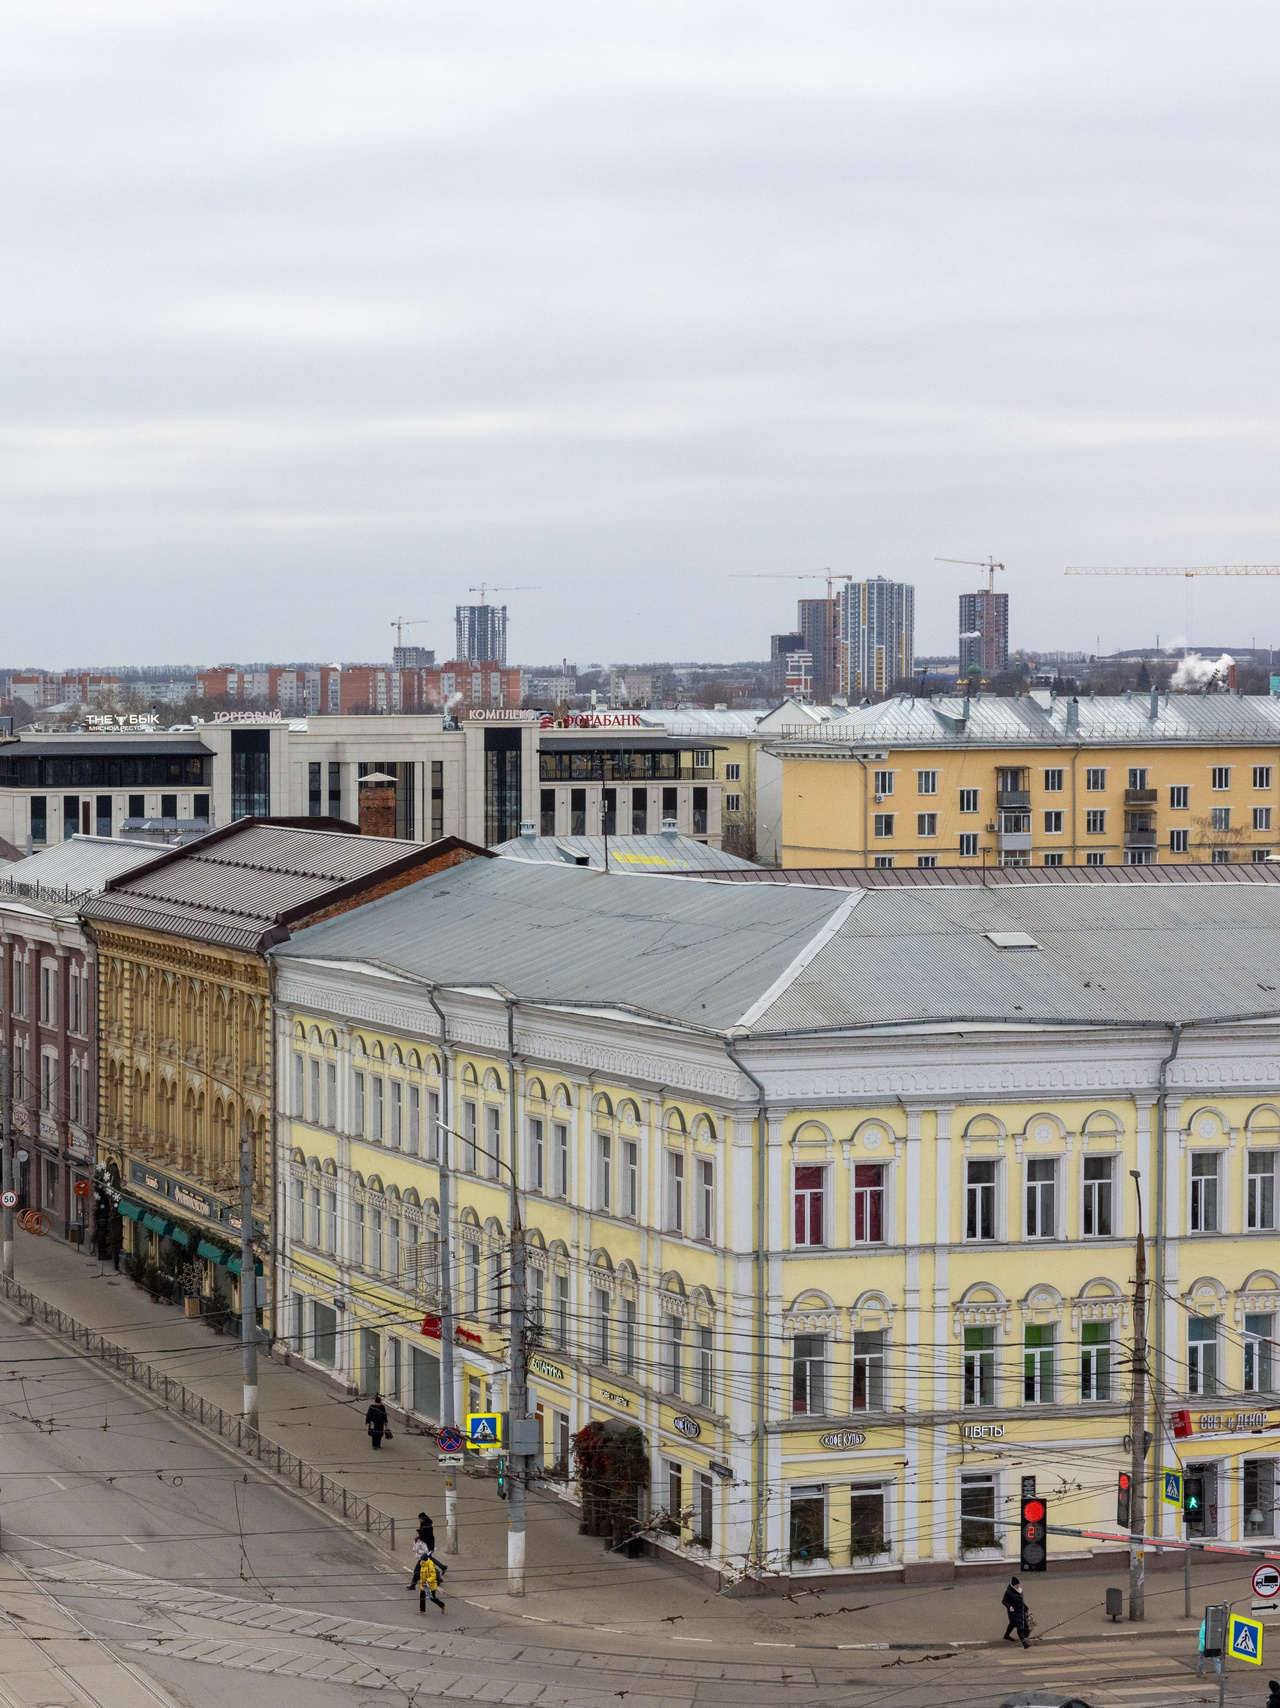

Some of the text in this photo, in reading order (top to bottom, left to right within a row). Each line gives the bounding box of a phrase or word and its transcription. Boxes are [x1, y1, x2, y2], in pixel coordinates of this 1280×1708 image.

[86, 714, 160, 724] THE БЫК
[213, 709, 282, 721] ТОРГОВЫЙ
[469, 709, 535, 720] КОМПЛЕКС
[562, 714, 641, 727] ФОРАБАНК
[4, 1195, 15, 1203] 50
[1201, 1414, 1223, 1429] СВЕТ
[1236, 1413, 1269, 1430] ДЕКОР
[965, 1425, 1005, 1440] ЦВЕТЫ
[824, 1433, 863, 1446] КОФЕ КУЛЬТ
[1027, 1526, 1035, 1538] 2
